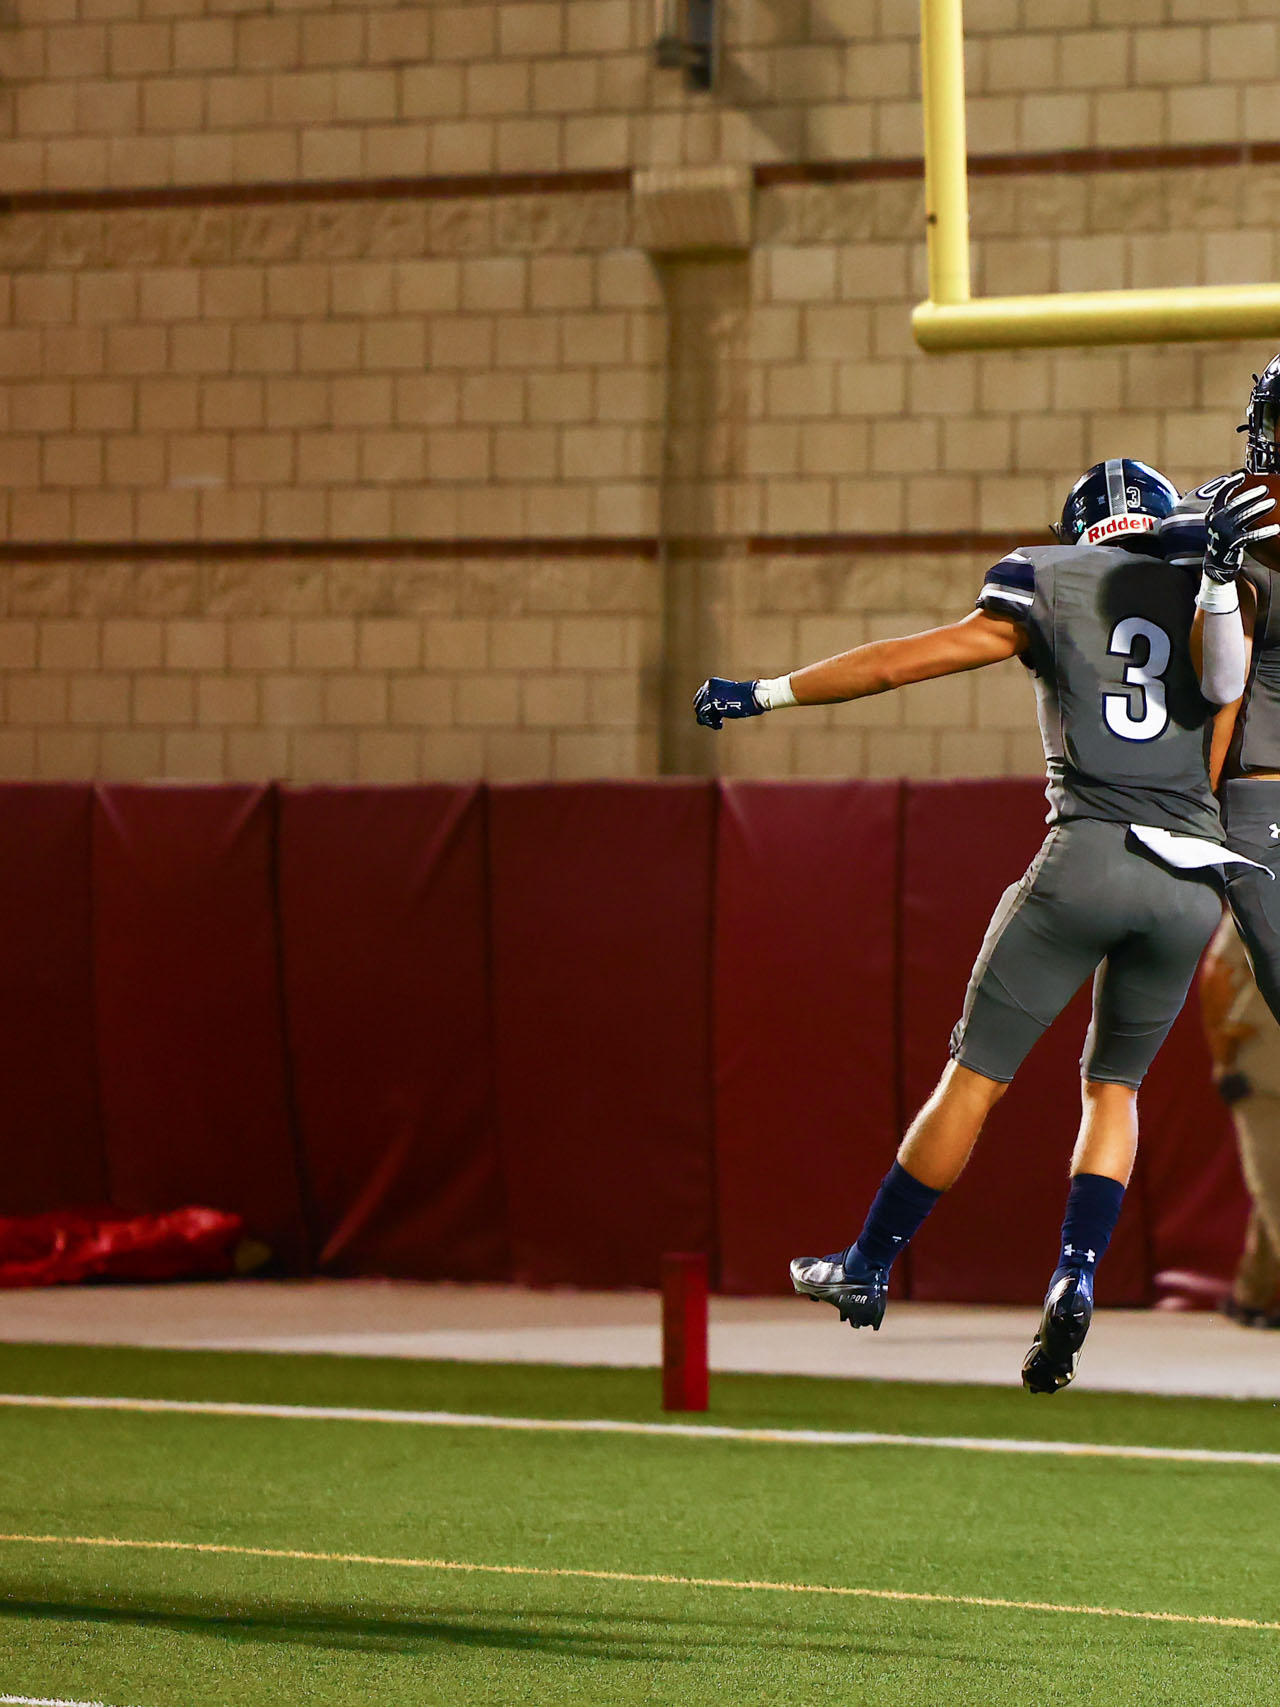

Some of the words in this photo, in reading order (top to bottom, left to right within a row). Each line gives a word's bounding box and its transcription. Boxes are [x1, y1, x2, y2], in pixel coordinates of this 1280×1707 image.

[1125, 486, 1141, 509] 3
[1087, 516, 1155, 544] Riddell
[1102, 616, 1171, 743] 3
